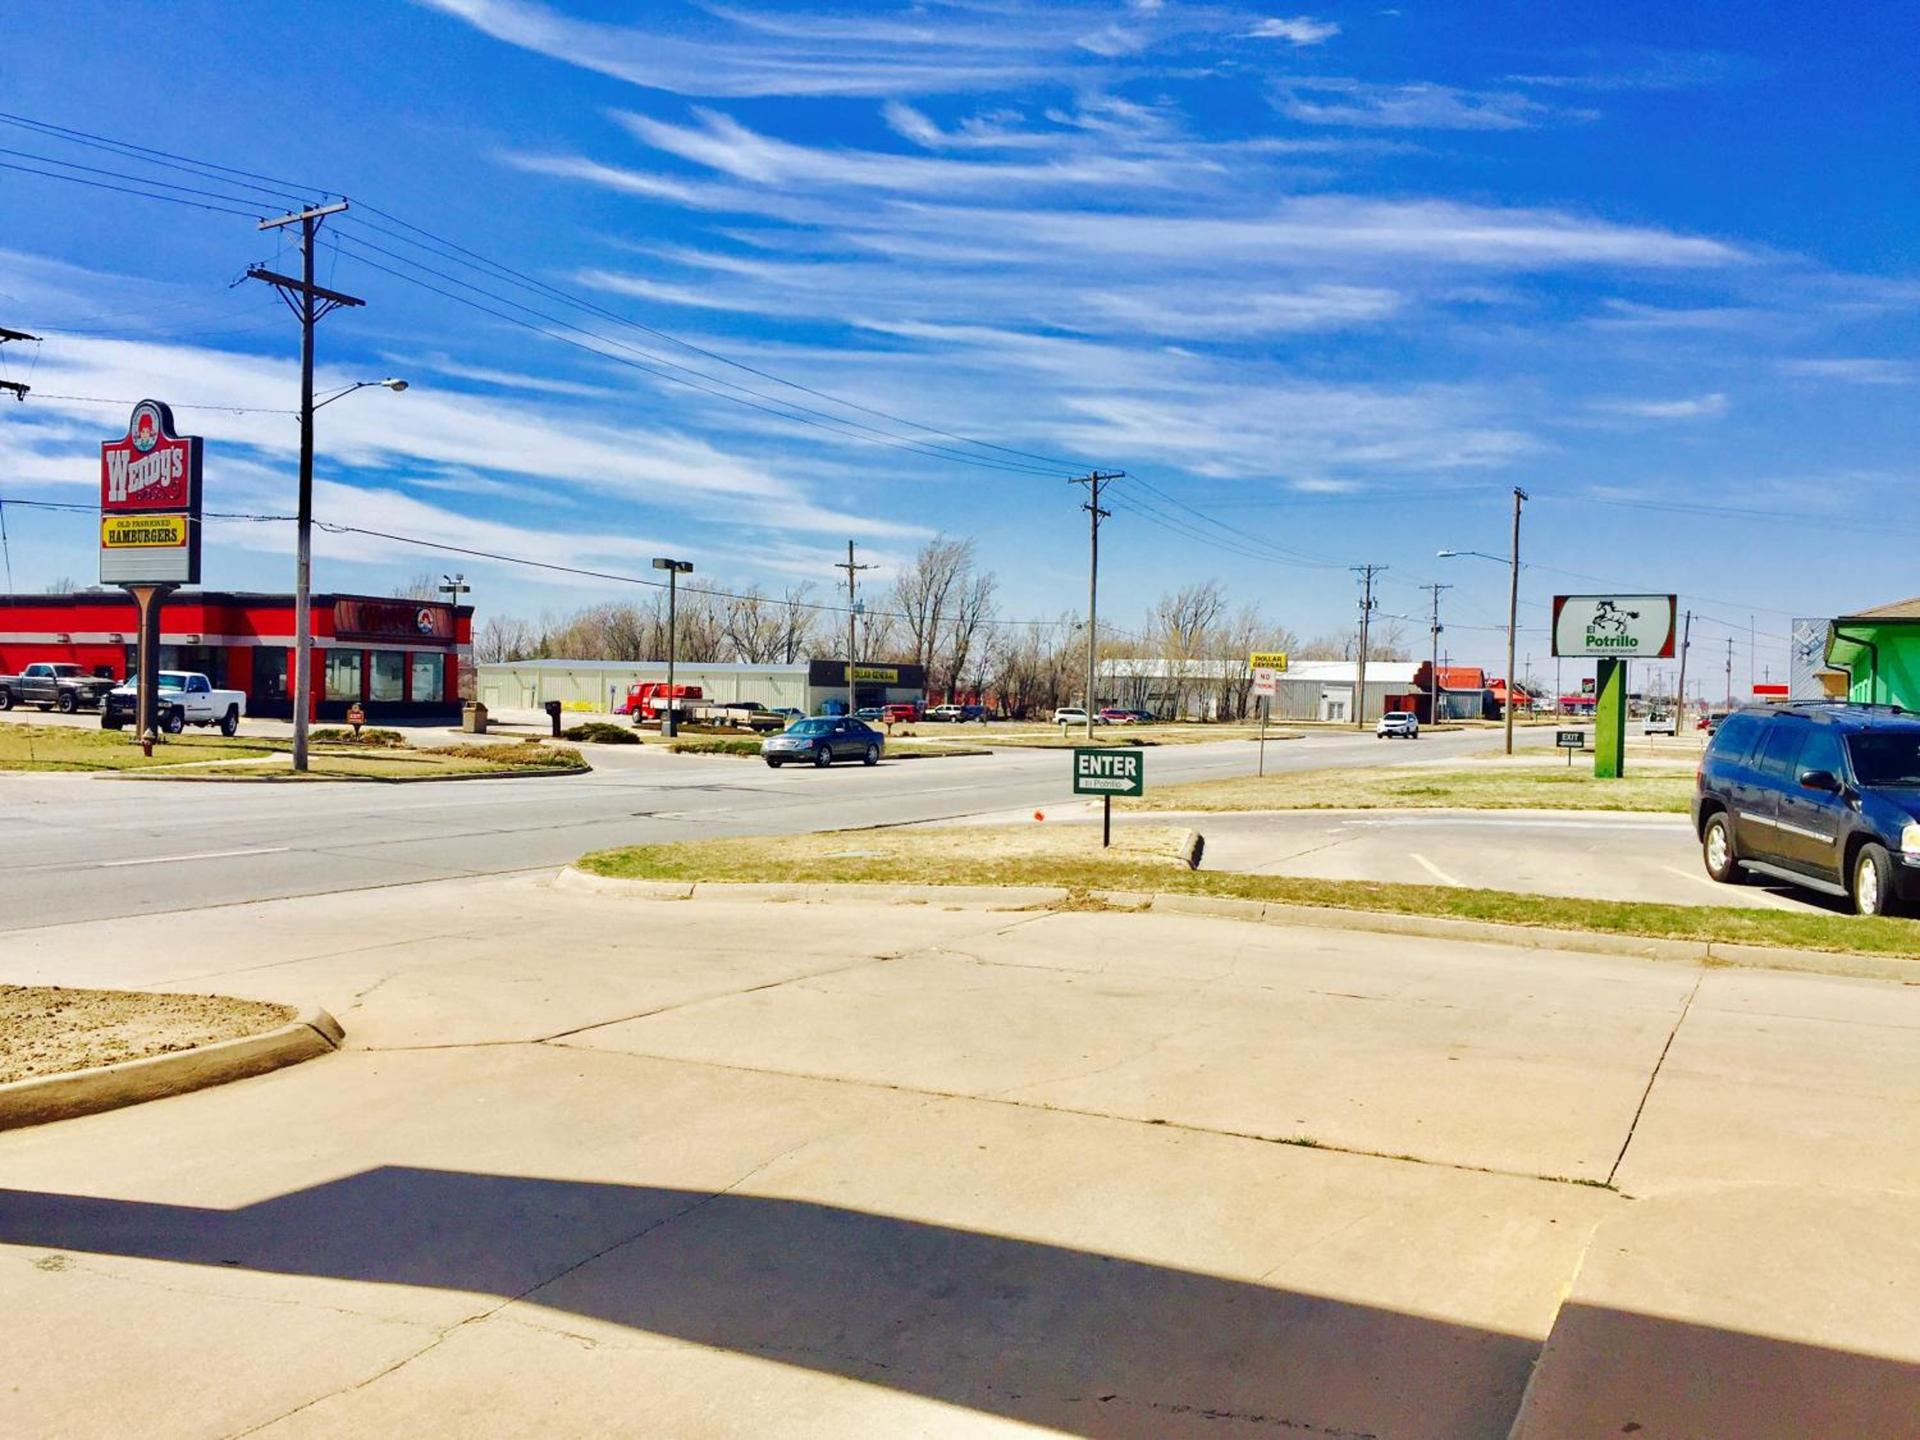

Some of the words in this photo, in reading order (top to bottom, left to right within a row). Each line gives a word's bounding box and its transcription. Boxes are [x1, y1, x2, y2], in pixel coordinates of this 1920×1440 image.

[108, 528, 177, 544] HAMBURGERS
[1586, 625, 1596, 634] El
[1585, 635, 1639, 648] Potrillo
[1260, 673, 1271, 681] NO
[1562, 733, 1579, 741] EXIT
[1079, 755, 1137, 776] ENTER
